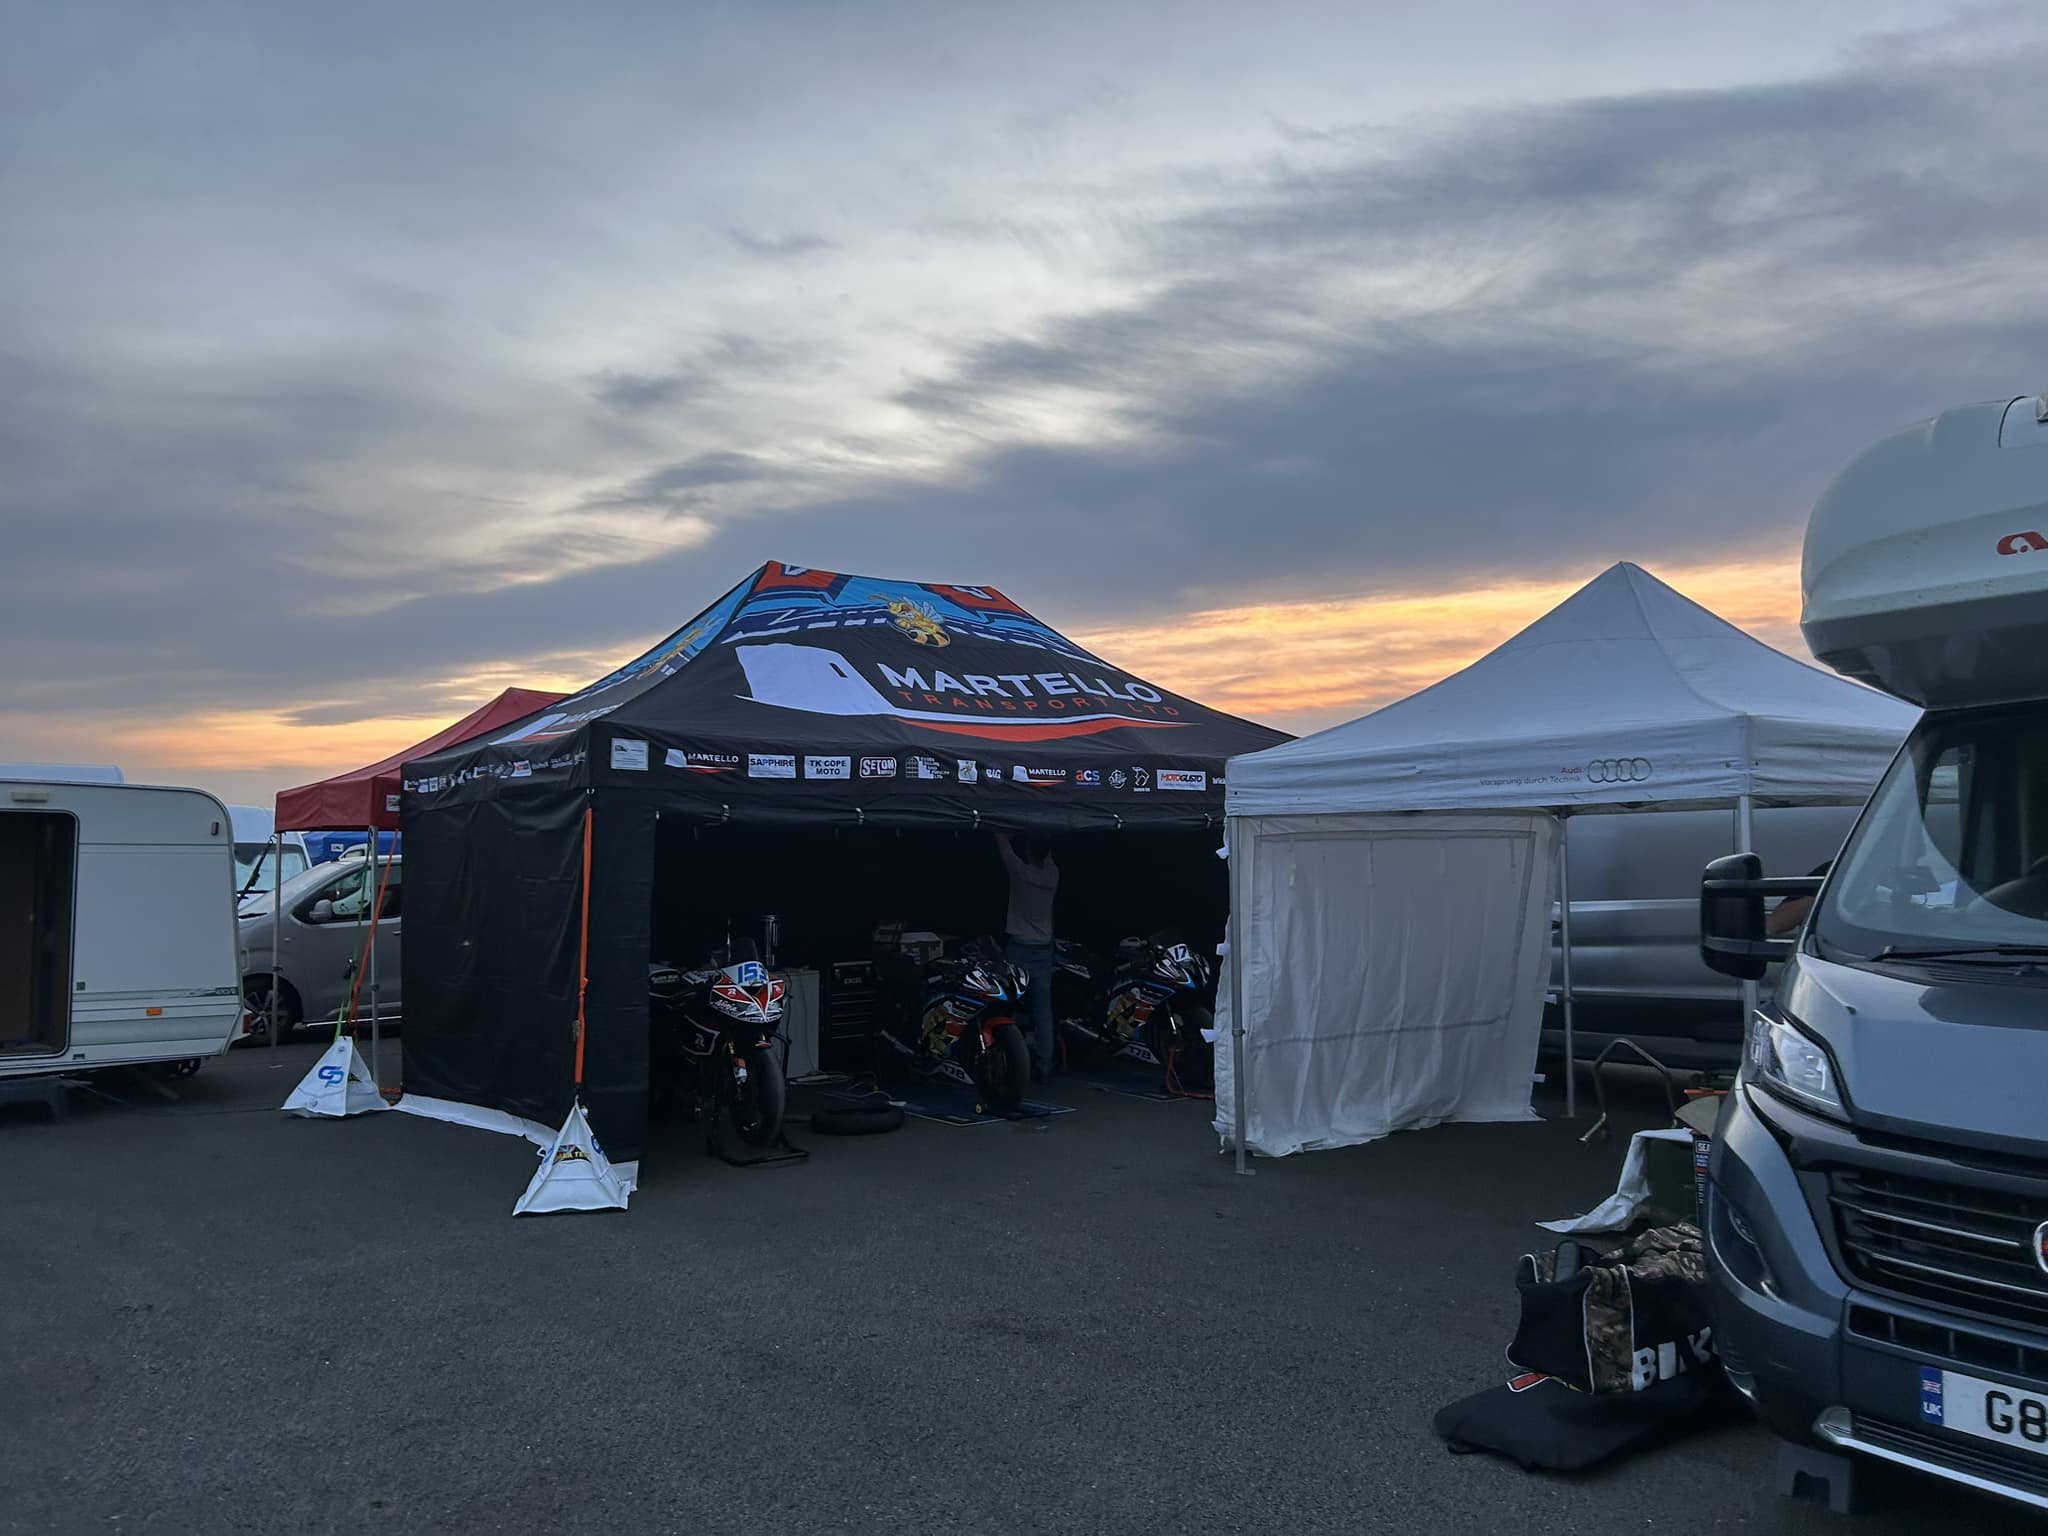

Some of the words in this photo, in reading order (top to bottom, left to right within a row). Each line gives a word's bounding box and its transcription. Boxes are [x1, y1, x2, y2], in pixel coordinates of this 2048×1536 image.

[877, 663, 1163, 703] MARTELLO
[898, 691, 1108, 711] TRANSPORT
[1127, 703, 1180, 716] LTD
[688, 752, 740, 763] MARTELLO
[750, 758, 795, 767] SAPPHIRE
[862, 759, 894, 775] SETON
[1028, 767, 1067, 777] MARTELLO
[1524, 775, 1547, 784] durch
[1922, 1400, 1942, 1416] UK
